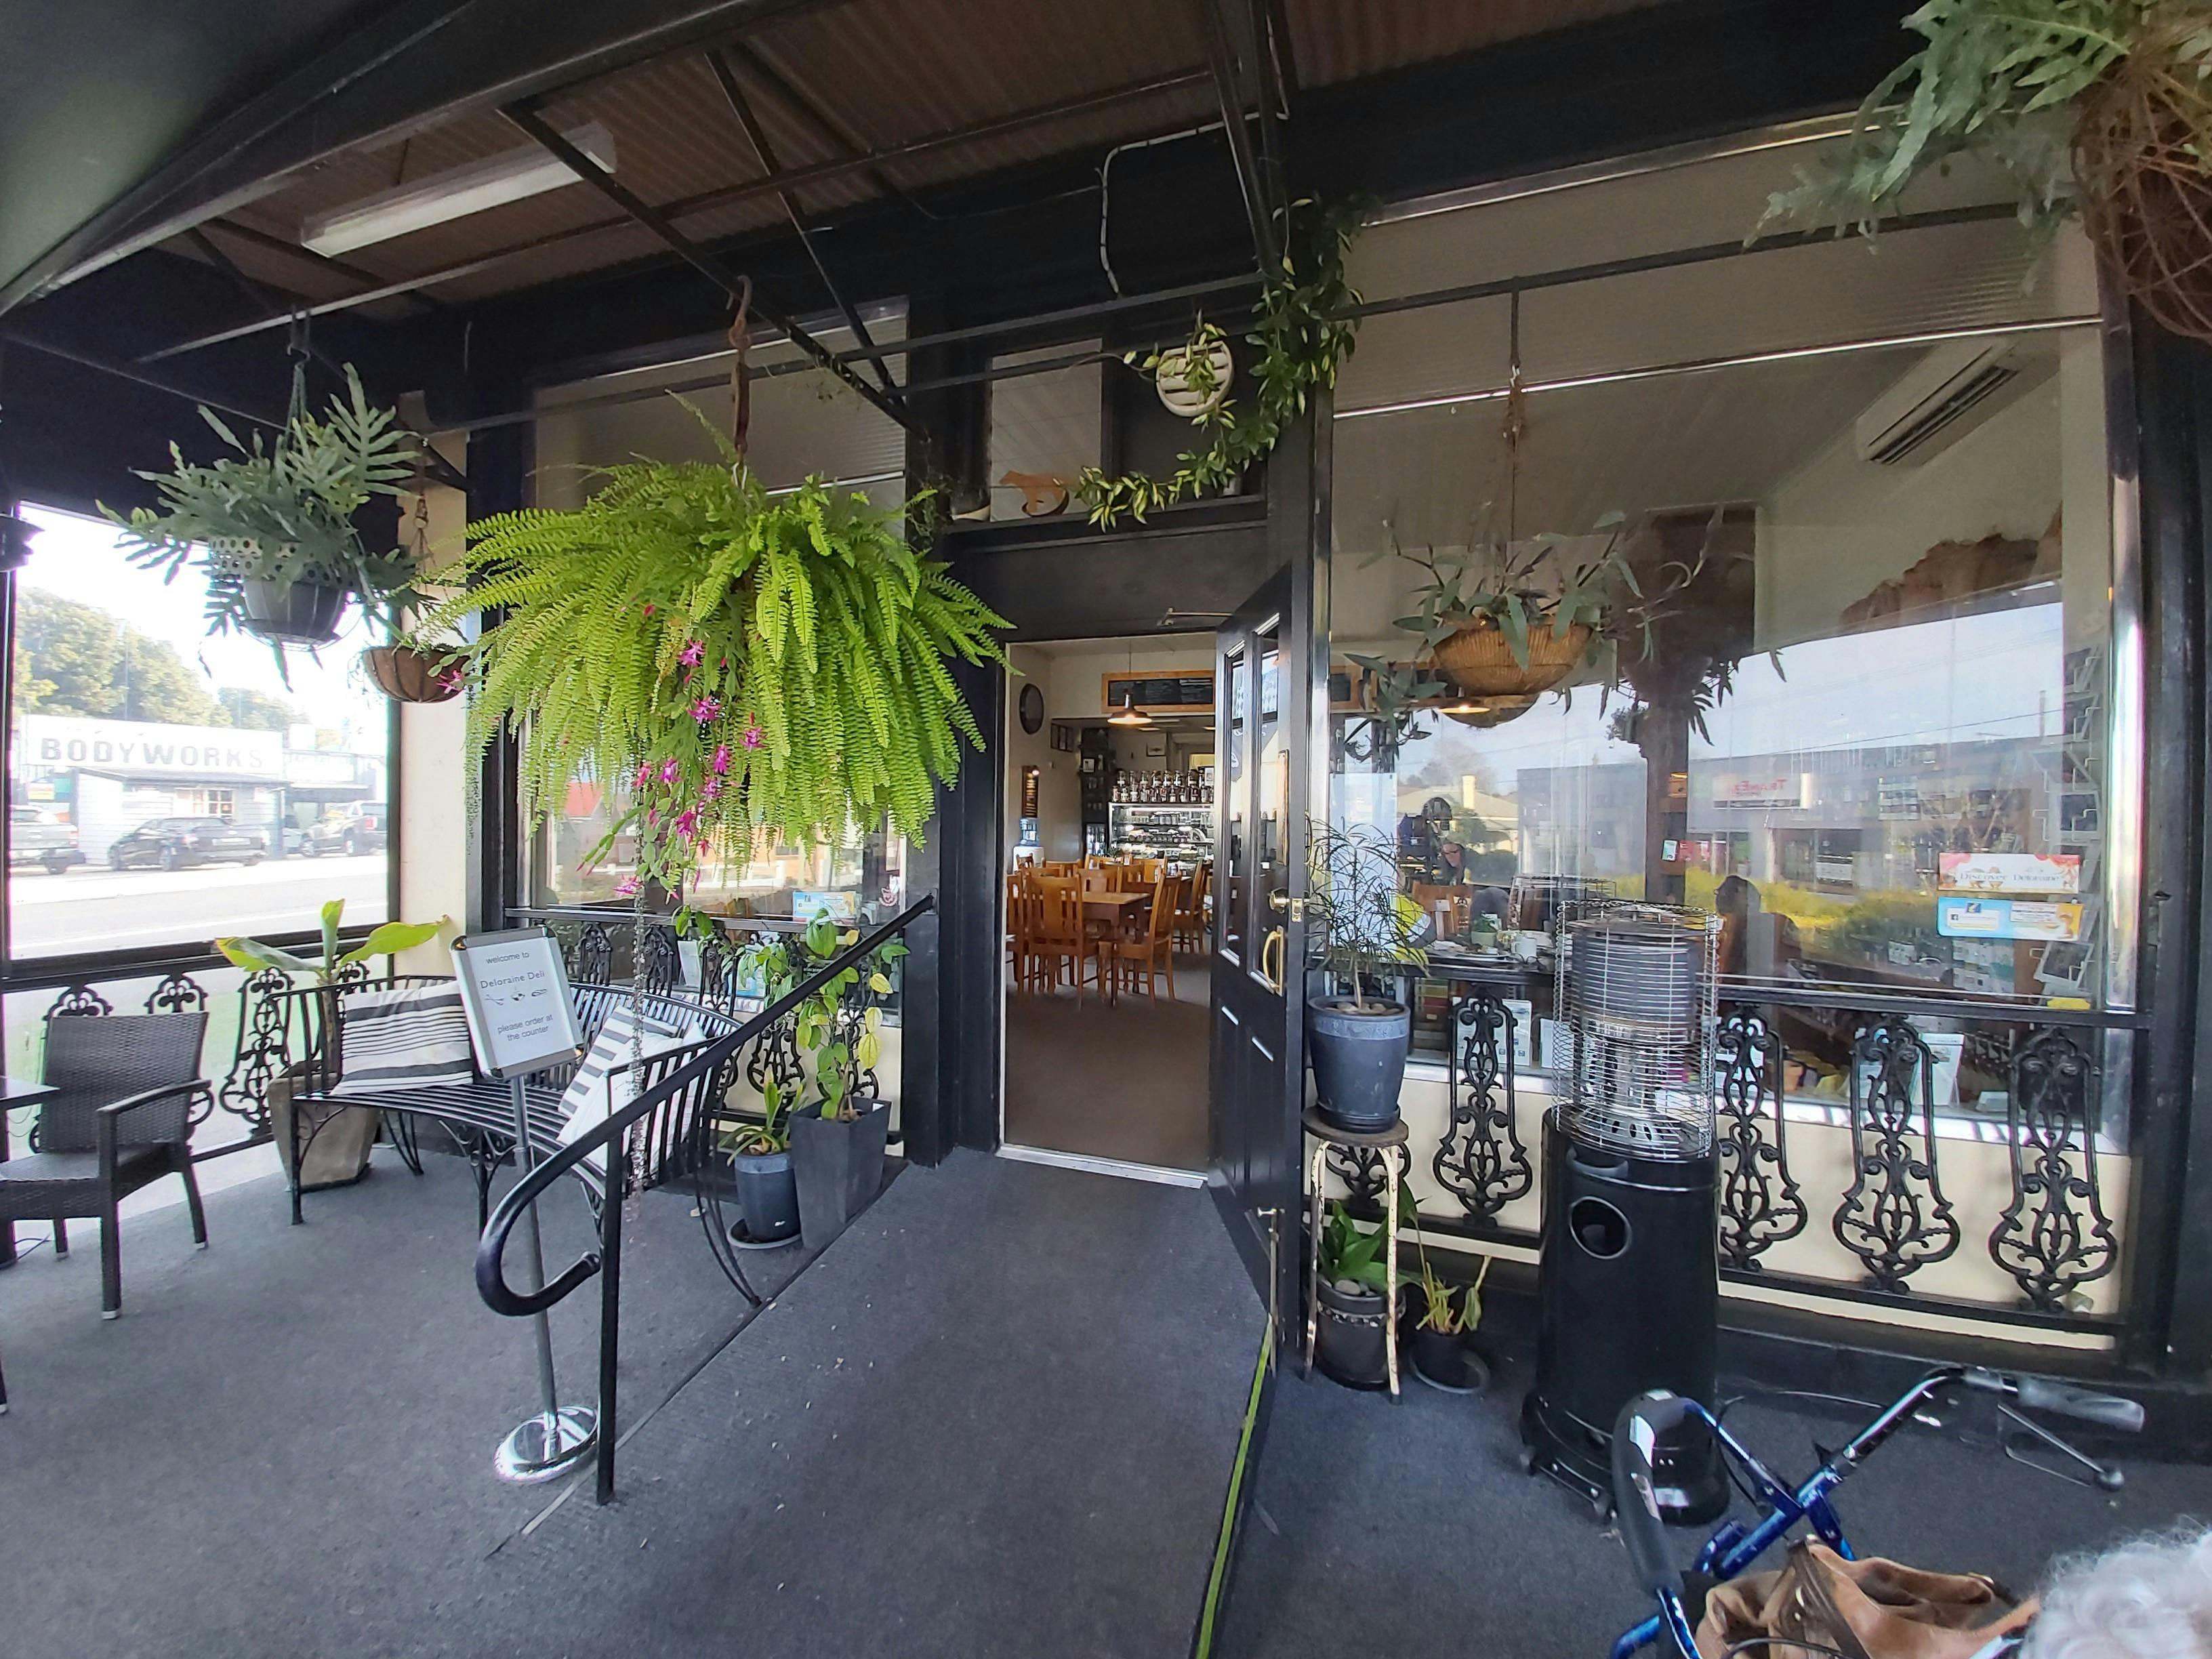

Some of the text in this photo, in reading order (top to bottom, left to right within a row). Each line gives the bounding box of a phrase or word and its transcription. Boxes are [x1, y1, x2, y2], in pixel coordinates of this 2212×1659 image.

[40, 737, 263, 769] BODYWORKS
[1960, 872, 2006, 880] Discover
[486, 954, 520, 964] welcome
[480, 970, 545, 989] Deloraine Deli
[497, 1022, 524, 1034] please
[525, 1017, 544, 1026] order
[507, 1026, 548, 1041] the counter
